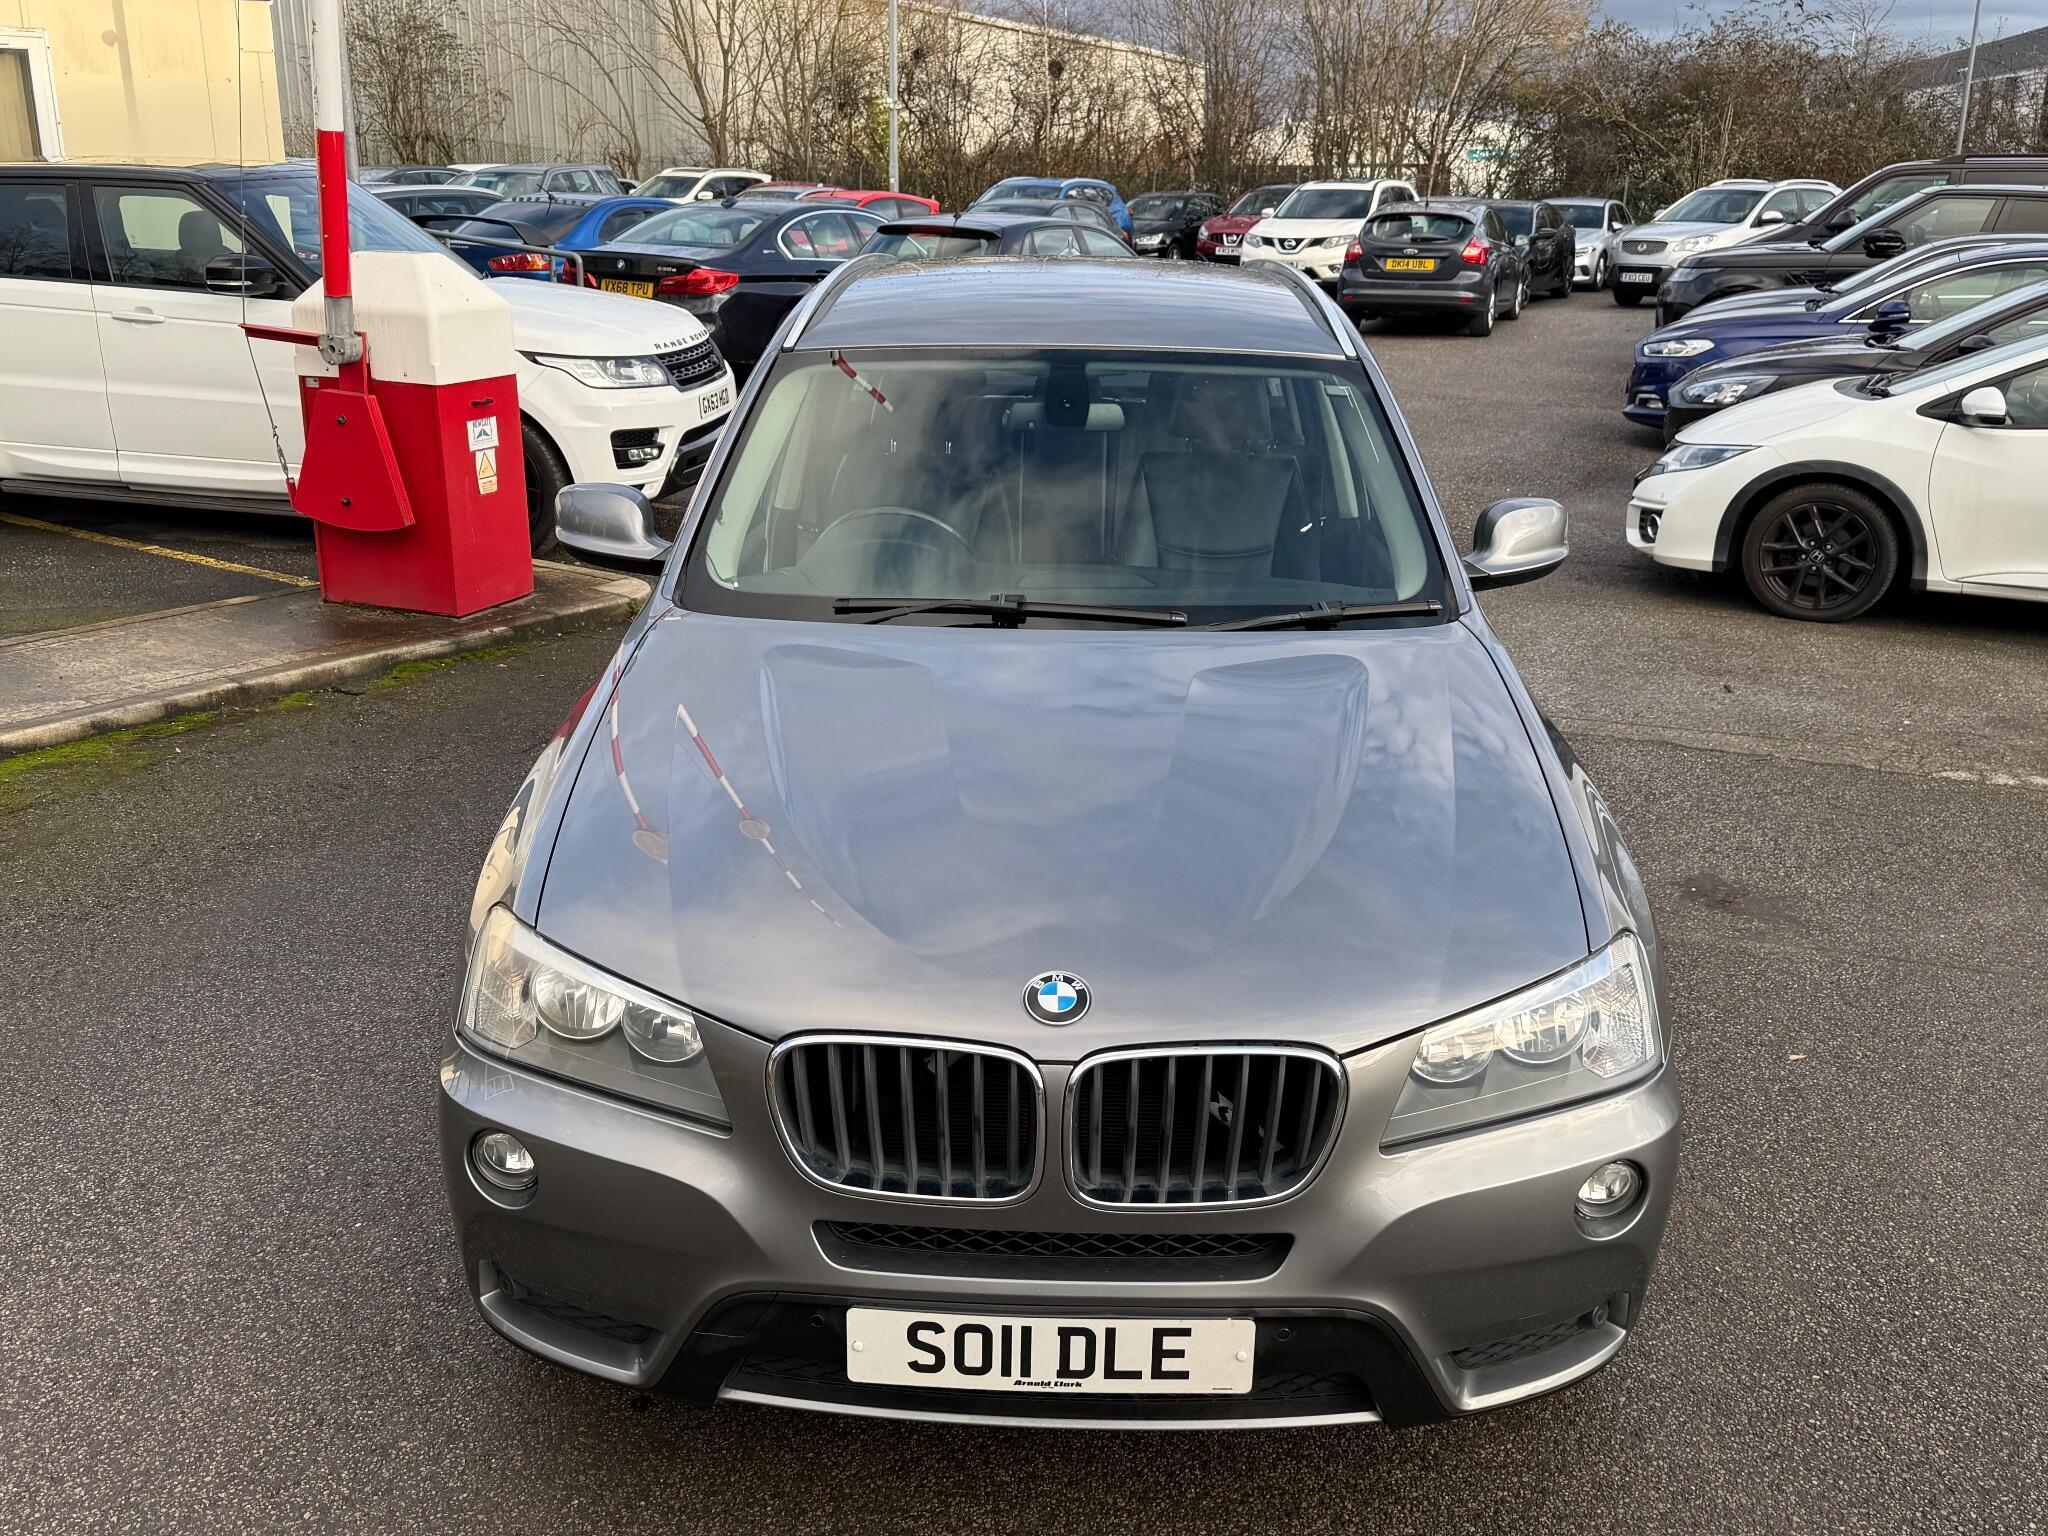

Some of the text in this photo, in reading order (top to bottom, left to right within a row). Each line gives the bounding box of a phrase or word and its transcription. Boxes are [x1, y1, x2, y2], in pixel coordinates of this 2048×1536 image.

[1391, 260, 1428, 268] DK14 UBL
[605, 279, 649, 295] VX68 TPU
[654, 329, 708, 351] RANGE ROVER
[702, 392, 719, 414] GX63
[1032, 974, 1084, 991] BMW
[906, 1320, 1192, 1381] SO11 DLE
[1013, 1379, 1051, 1387] Arnold
